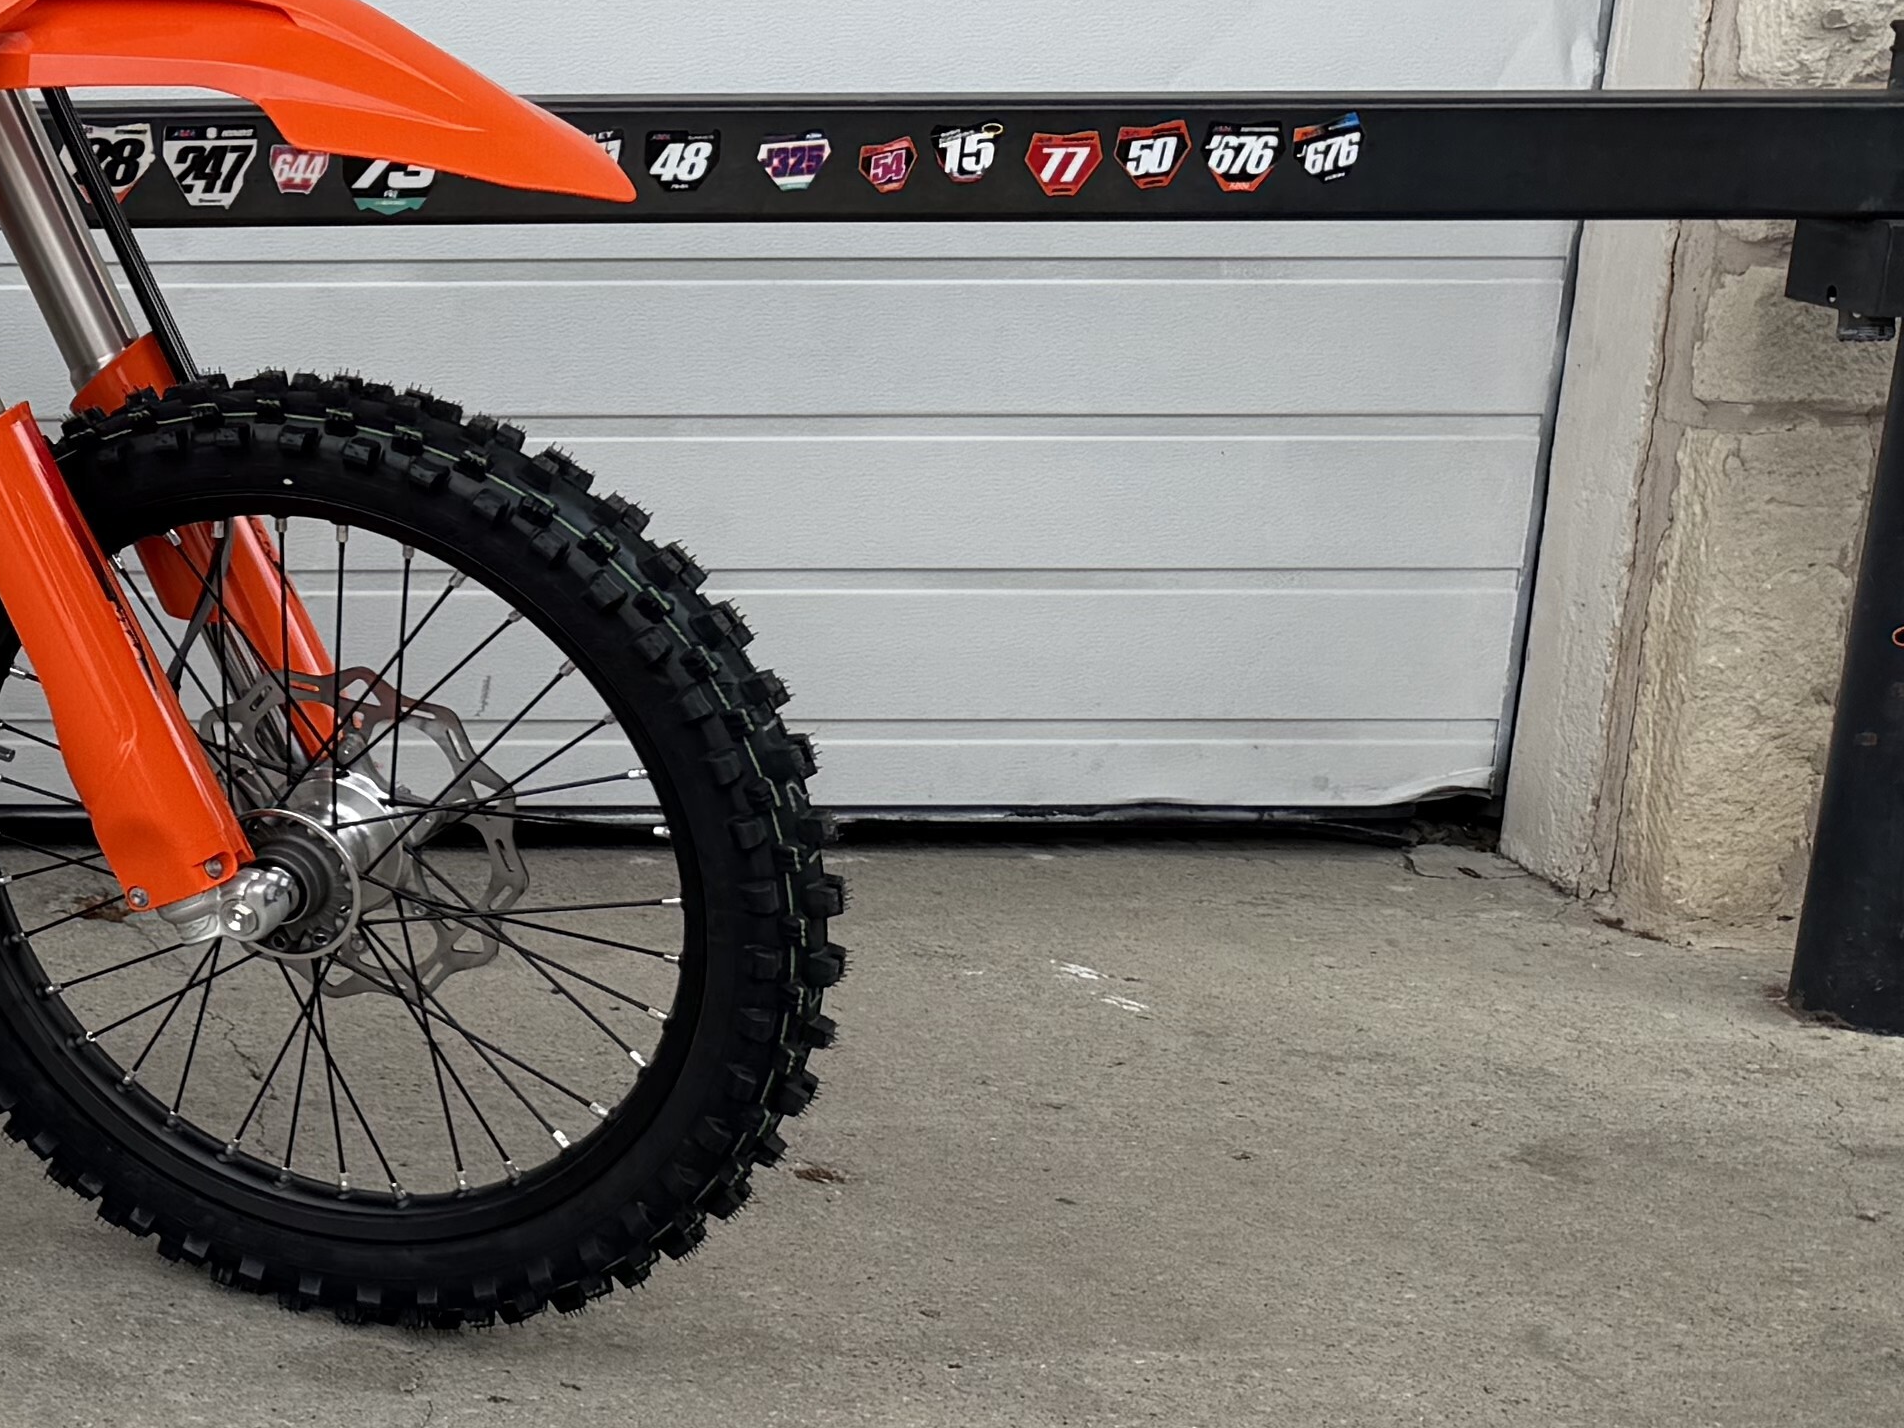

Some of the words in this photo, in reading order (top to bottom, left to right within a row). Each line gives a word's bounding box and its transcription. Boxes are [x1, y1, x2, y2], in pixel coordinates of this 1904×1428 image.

[174, 145, 253, 194] 247
[273, 153, 324, 184] 644
[649, 142, 712, 181] 48
[872, 150, 905, 184] 54
[939, 132, 995, 174] 15
[1040, 147, 1090, 182] 77
[1126, 137, 1177, 176] 50
